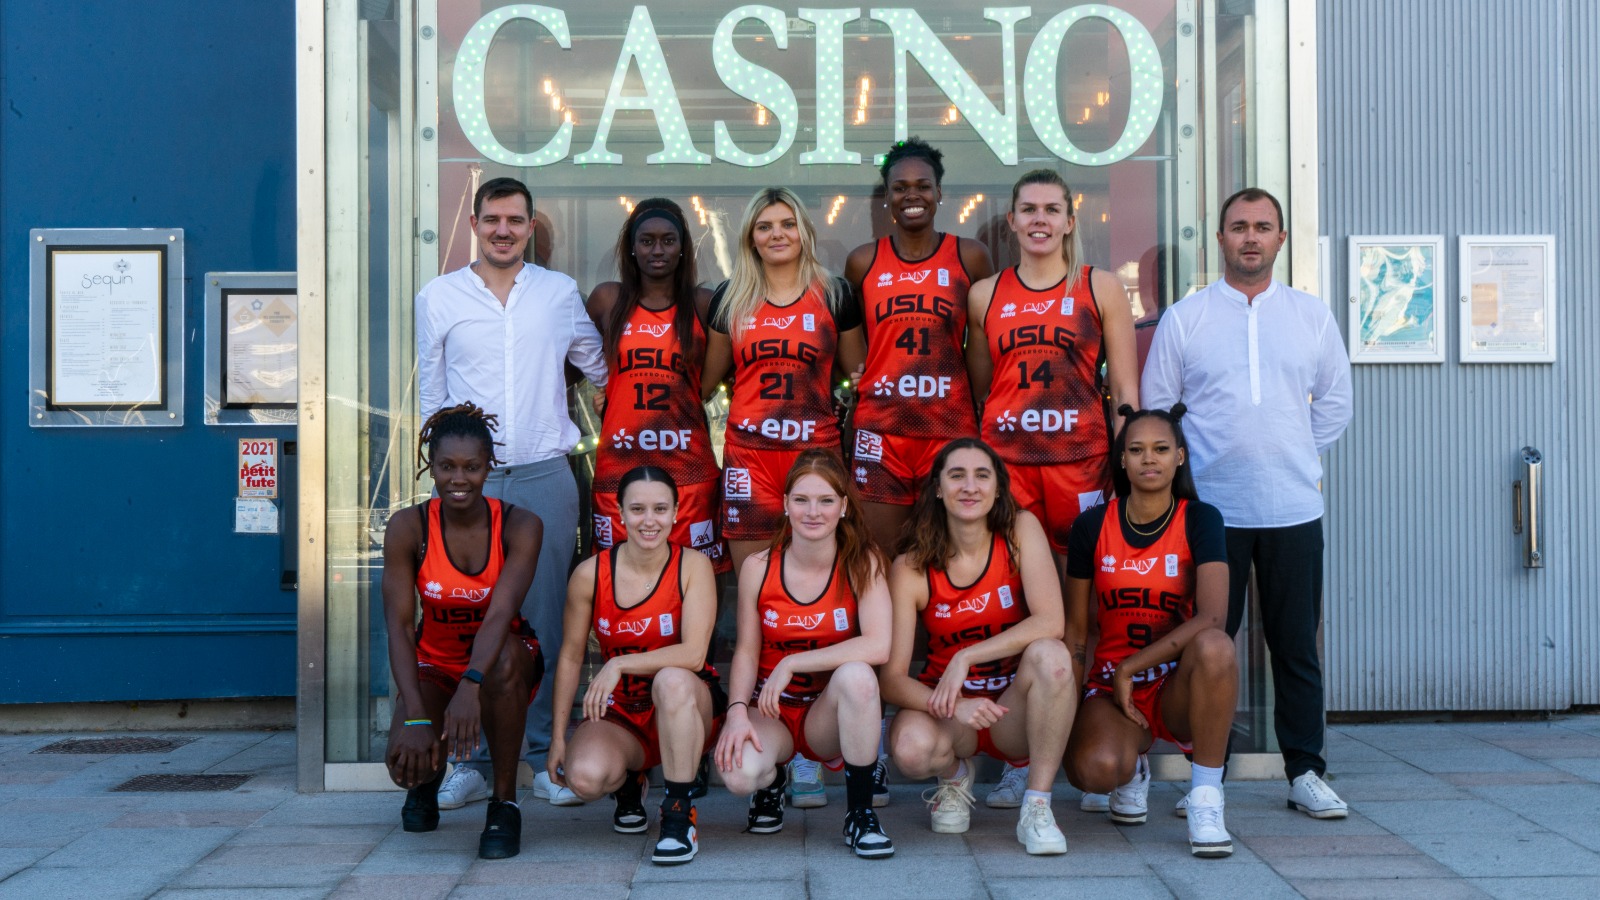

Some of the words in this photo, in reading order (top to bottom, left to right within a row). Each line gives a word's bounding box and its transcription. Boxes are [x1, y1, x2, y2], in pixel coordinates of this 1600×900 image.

[452, 3, 1164, 166] CASINO
[81, 273, 133, 295] Sequin
[899, 271, 929, 282] CMN
[876, 294, 954, 325] USLG
[1023, 301, 1053, 312] CMN
[638, 324, 670, 335] CMN
[763, 316, 793, 327] CMN
[896, 327, 931, 355] 41
[998, 325, 1076, 355] USLG
[741, 339, 819, 370] USLG
[1018, 360, 1054, 389] 14
[760, 373, 794, 400] 21
[633, 383, 671, 410] 12
[242, 442, 274, 455] 2021
[240, 464, 276, 480] petit
[1122, 558, 1155, 572] CMN
[450, 587, 488, 600] CMN
[1101, 588, 1182, 613] USLG
[957, 595, 988, 611] CMN
[432, 607, 486, 624] USL
[786, 614, 822, 627] CMN
[617, 619, 650, 633] CMN
[1127, 624, 1152, 650] 9
